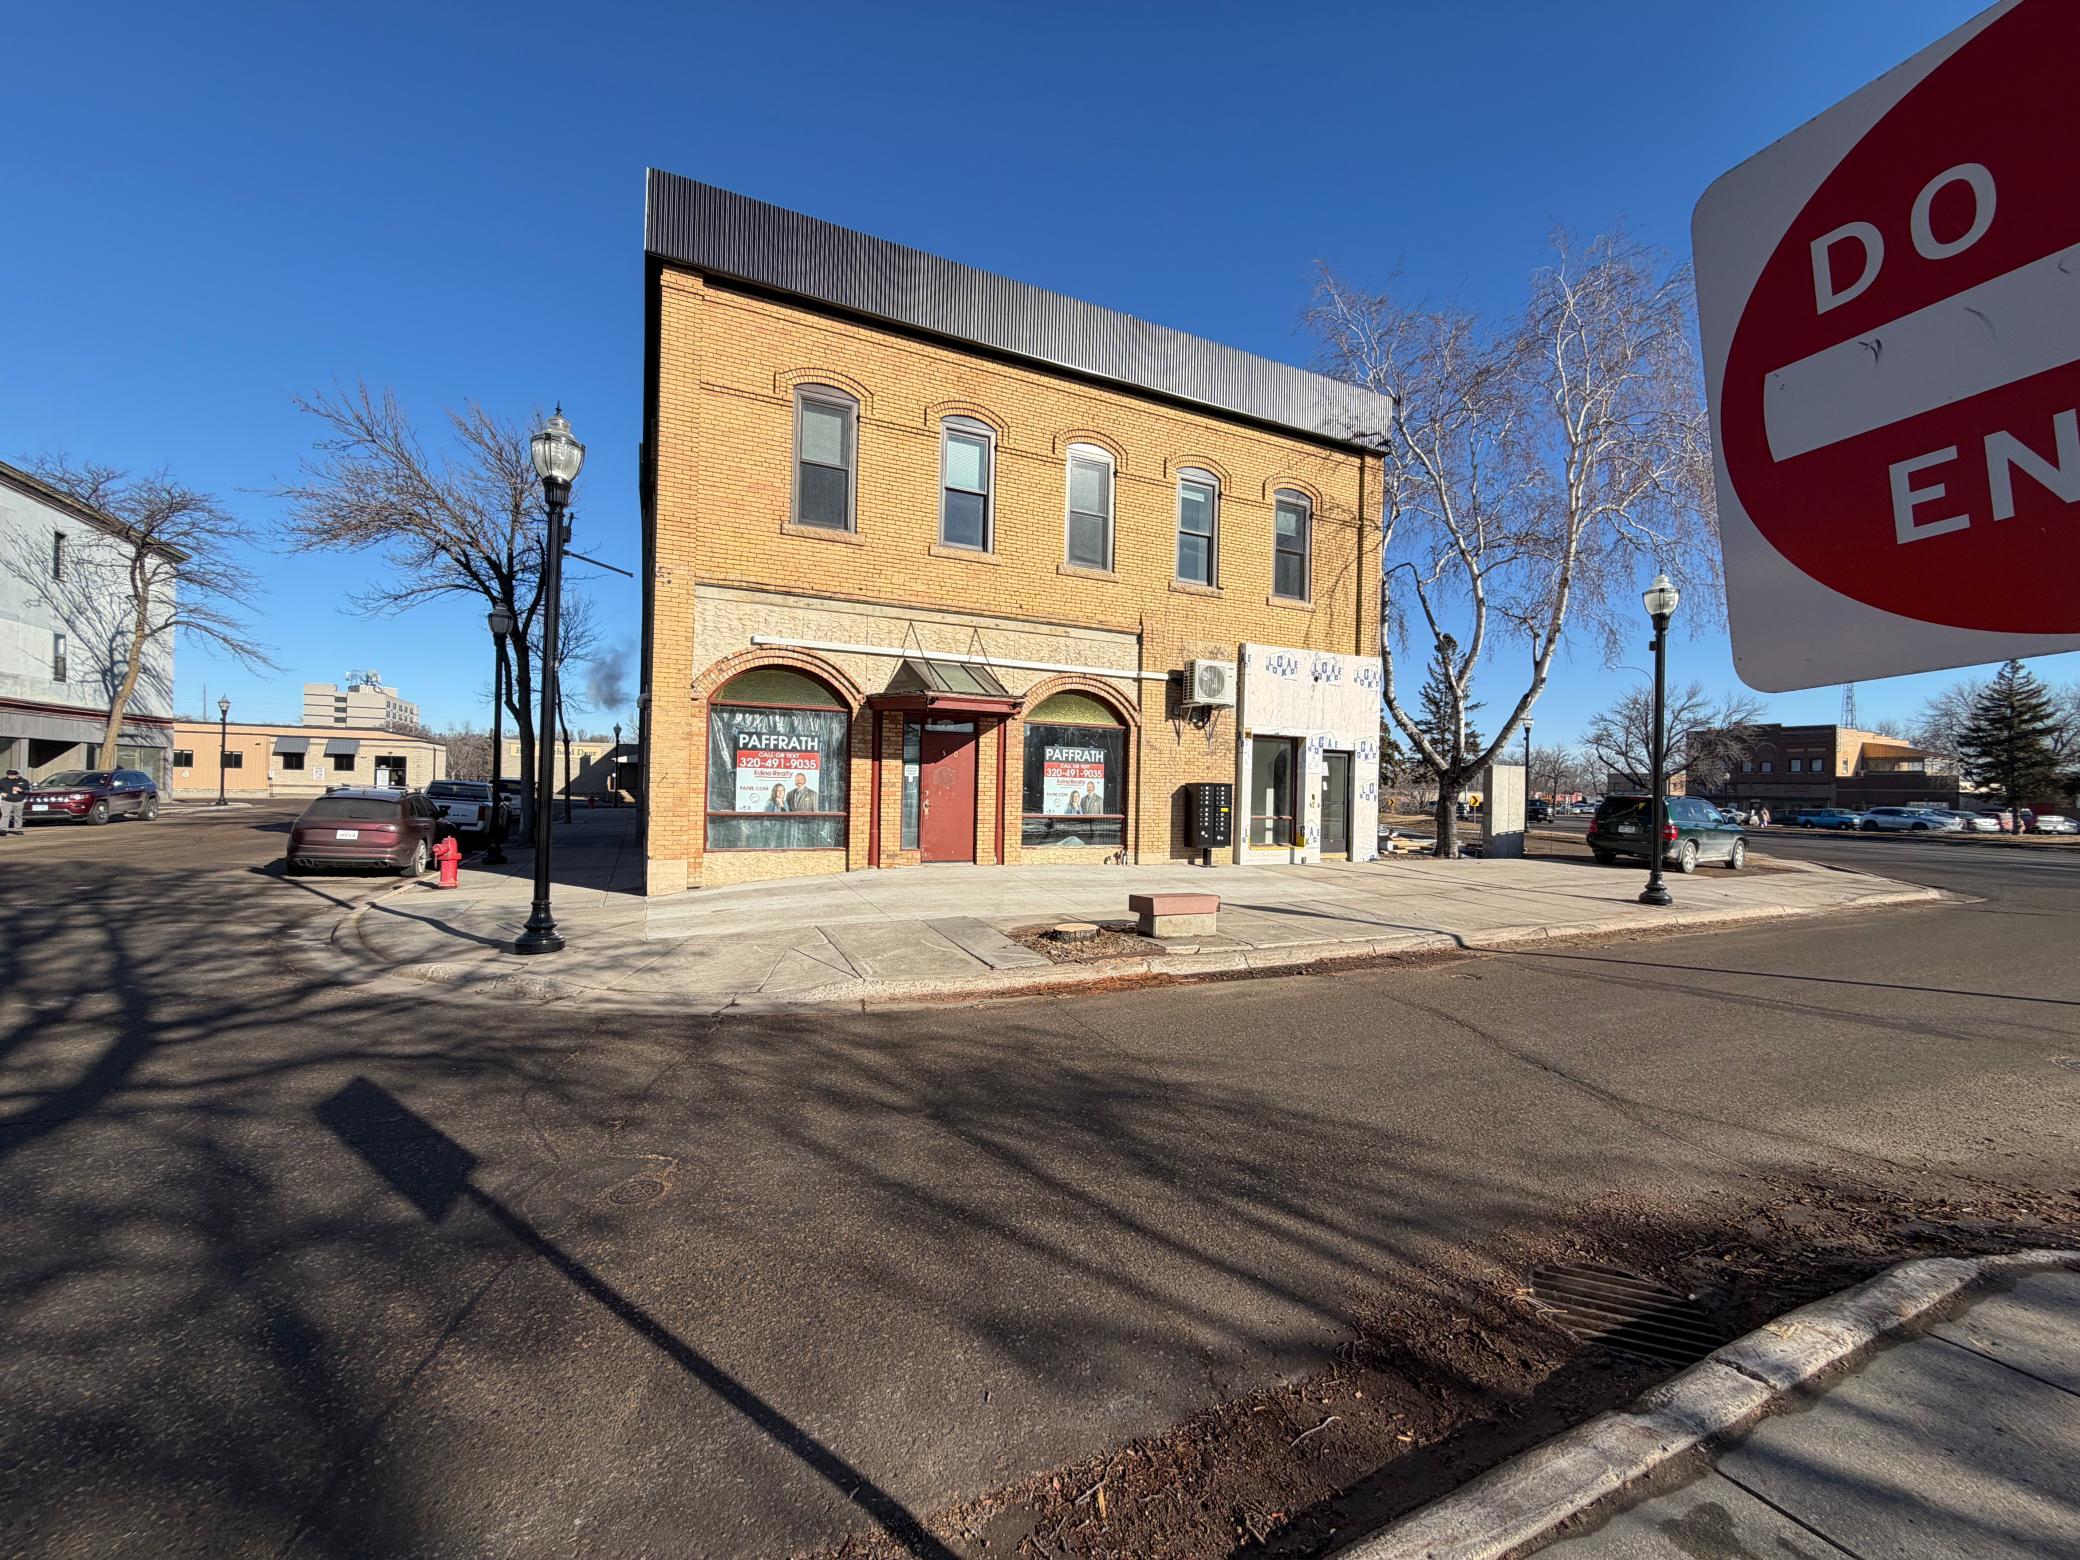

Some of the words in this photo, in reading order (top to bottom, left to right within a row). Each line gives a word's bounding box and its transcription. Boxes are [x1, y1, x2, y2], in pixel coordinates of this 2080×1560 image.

[1810, 162, 1997, 315] DO
[739, 734, 818, 750] PAFFRATH
[1046, 749, 1104, 762] PAFFRATH
[739, 757, 817, 769] 320-491-9035
[773, 770, 793, 778] Realty
[1046, 768, 1102, 778] 320-491-9035
